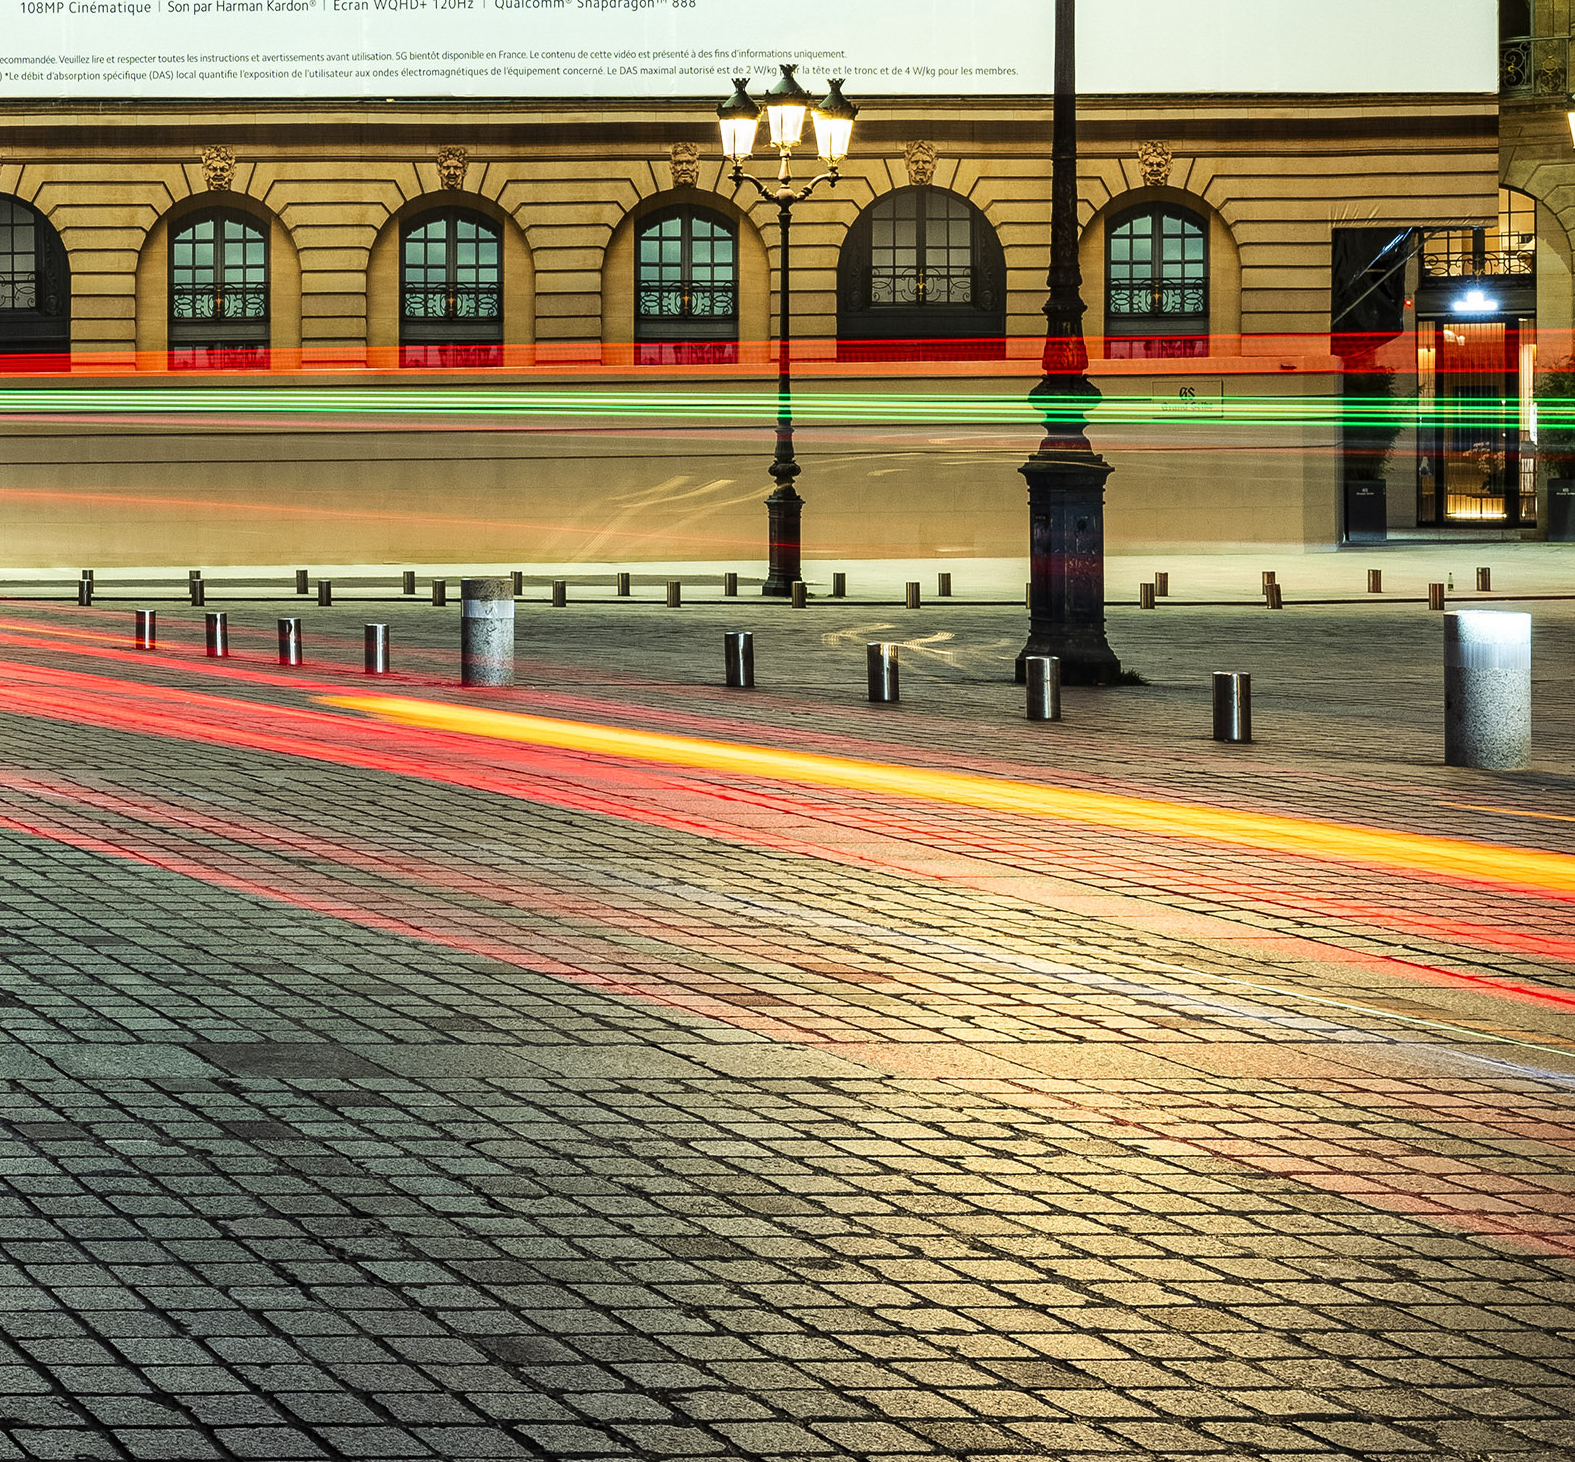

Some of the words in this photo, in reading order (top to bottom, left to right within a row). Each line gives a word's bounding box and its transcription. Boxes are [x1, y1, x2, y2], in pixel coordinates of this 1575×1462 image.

[20, 1, 65, 15] 108MP
[68, 0, 152, 18] Cinématique
[166, 0, 191, 14] Son
[193, 2, 213, 17] par
[215, 0, 264, 14] Harman
[58, 54, 91, 65] Veuillez
[91, 54, 105, 65] lire
[105, 55, 116, 65] et
[116, 54, 157, 67] respecter
[157, 54, 186, 64] toutes
[186, 53, 199, 63] les
[199, 52, 250, 63] instructions
[250, 53, 261, 63] et
[261, 52, 325, 63] avertissements
[325, 52, 350, 62] avant
[395, 50, 408, 61] 5G
[409, 50, 441, 61] bientôt
[441, 49, 485, 63] disponible
[485, 51, 497, 60] en
[529, 49, 540, 60] Le
[540, 50, 576, 60] contenu
[577, 49, 589, 60] de
[589, 49, 613, 60] cette
[613, 49, 637, 60] vidéo
[637, 50, 651, 60] est
[652, 49, 690, 62] présenté
[690, 49, 697, 59] à
[697, 48, 714, 59] des
[714, 48, 730, 59] fins
[730, 48, 793, 59] d'informations
[20, 71, 45, 81] débit
[45, 70, 101, 83] d'absorption
[102, 70, 148, 83] spécifique
[148, 69, 174, 82] (DAS)
[175, 69, 197, 80] local
[198, 68, 239, 81] quantifie
[239, 68, 290, 81] l'exposition
[290, 68, 303, 79] de
[304, 68, 354, 79] l'utilisateur
[354, 69, 371, 78] aux
[371, 67, 400, 78] ondes
[400, 66, 489, 79] électromagnétiques
[490, 66, 502, 76] de
[503, 66, 561, 79] l'équipement
[562, 66, 605, 77] concerné.
[606, 66, 618, 76] Le
[619, 65, 639, 76] DAS
[639, 65, 677, 76] maximal
[678, 65, 715, 75] autorisé
[716, 65, 731, 75] est
[732, 65, 744, 75] de
[745, 65, 752, 75] 2
[753, 65, 778, 77] W/kg
[802, 65, 810, 75] la
[811, 65, 831, 75] tête
[832, 65, 843, 75] et
[844, 65, 853, 75] le
[853, 66, 879, 76] tronc
[879, 66, 890, 76] et
[891, 65, 903, 76] de
[904, 66, 911, 76] 4
[912, 66, 936, 78] W/kg
[937, 68, 959, 79] pour
[960, 66, 974, 76] les
[974, 65, 1019, 76] membres.
